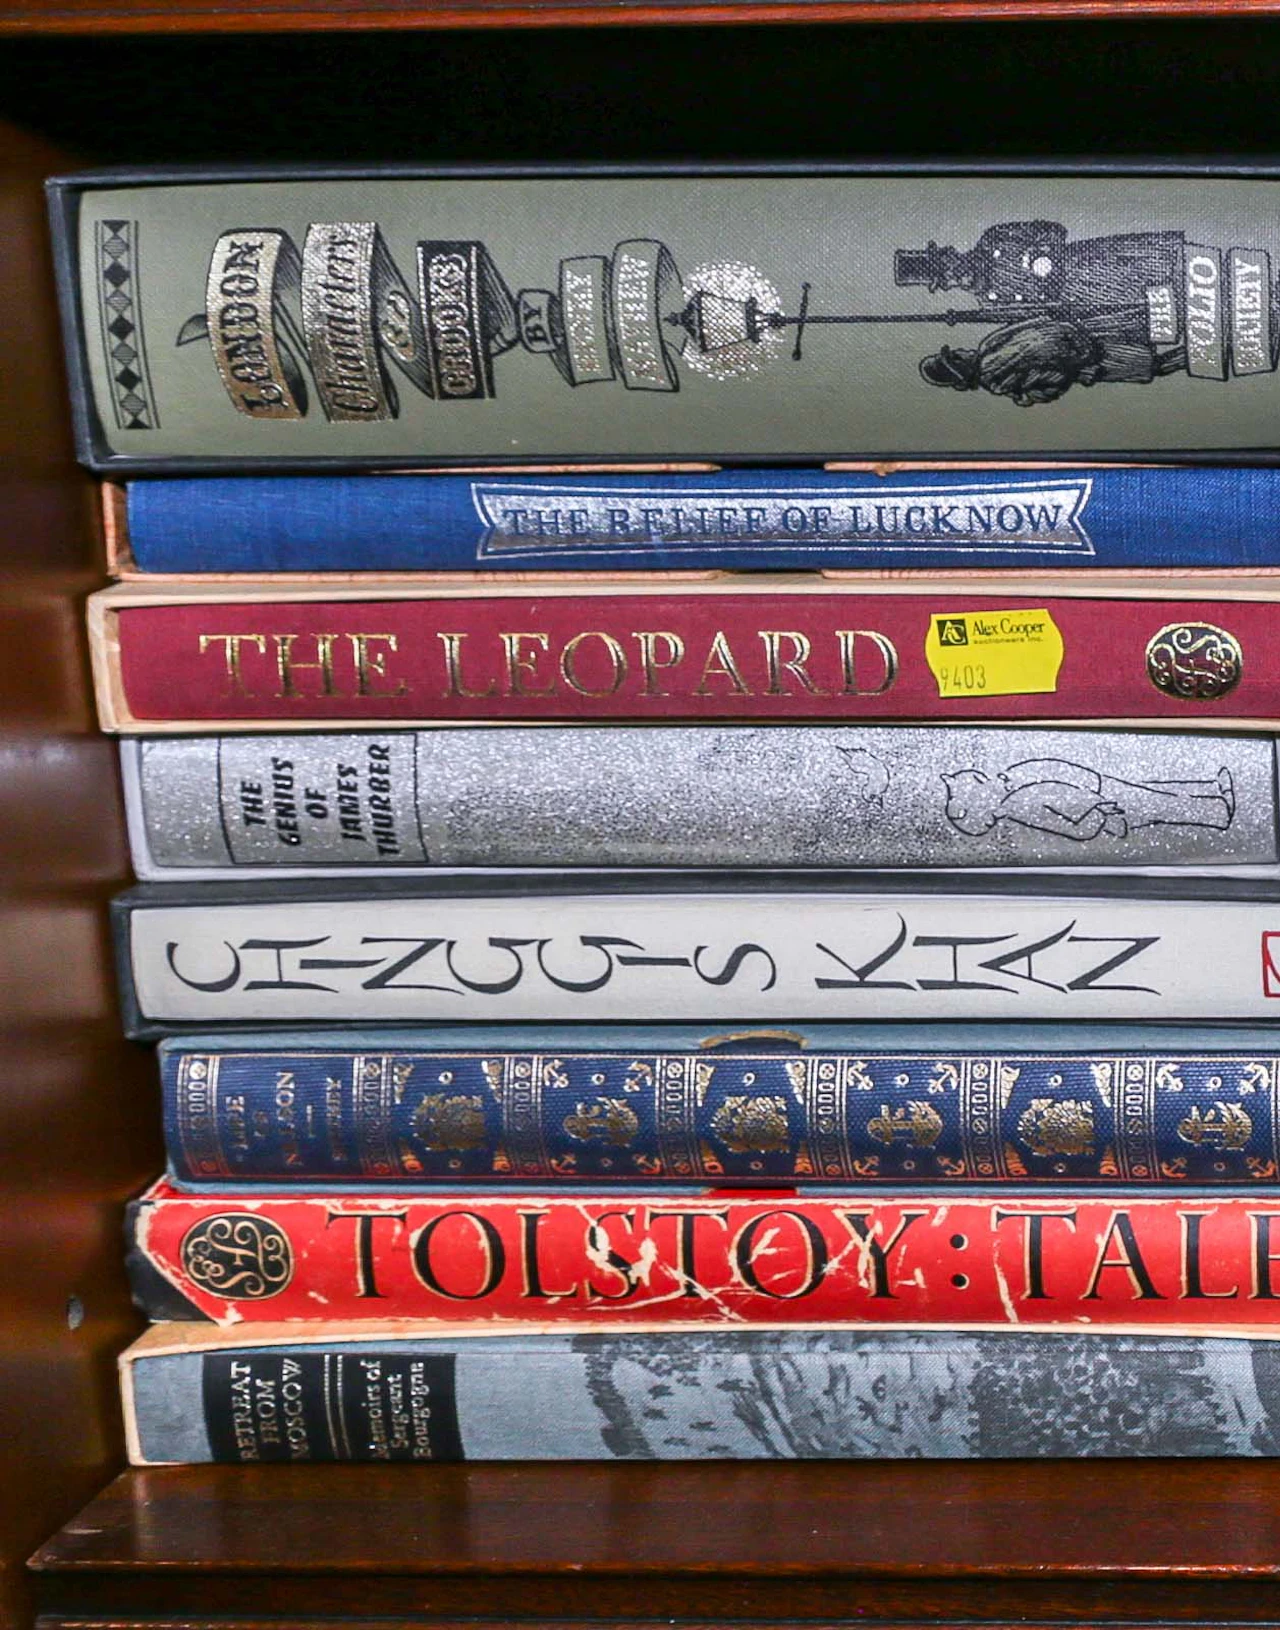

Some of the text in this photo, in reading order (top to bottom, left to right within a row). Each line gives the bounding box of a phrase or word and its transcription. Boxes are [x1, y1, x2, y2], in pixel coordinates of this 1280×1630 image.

[218, 239, 285, 412] LONDON
[324, 233, 379, 414] Characters
[428, 250, 475, 396] CROOKS
[523, 301, 548, 344] BY
[1147, 286, 1173, 337] THE
[1188, 256, 1217, 366] FOLIO
[1236, 258, 1264, 368] SOCIETY
[503, 502, 1064, 537] THE RELIEF OF LUCKNOW
[199, 630, 899, 698] THE LEOPARD
[973, 618, 1045, 638] Alex Cooper
[940, 664, 986, 691] 9403
[243, 779, 265, 829] THE
[270, 756, 304, 847] GENIUS
[303, 786, 329, 820] OF
[339, 763, 367, 846] JAMES
[363, 742, 400, 857] THURBER
[165, 911, 1162, 996] CHINGGIS KHAN
[230, 1361, 258, 1461] RETREAT
[255, 1378, 280, 1443] FROM
[282, 1357, 309, 1459] MOSCOW
[360, 1359, 388, 1460] Memoirs of
[387, 1372, 409, 1449] Sergeant
[409, 1362, 432, 1459] Bourgogne
